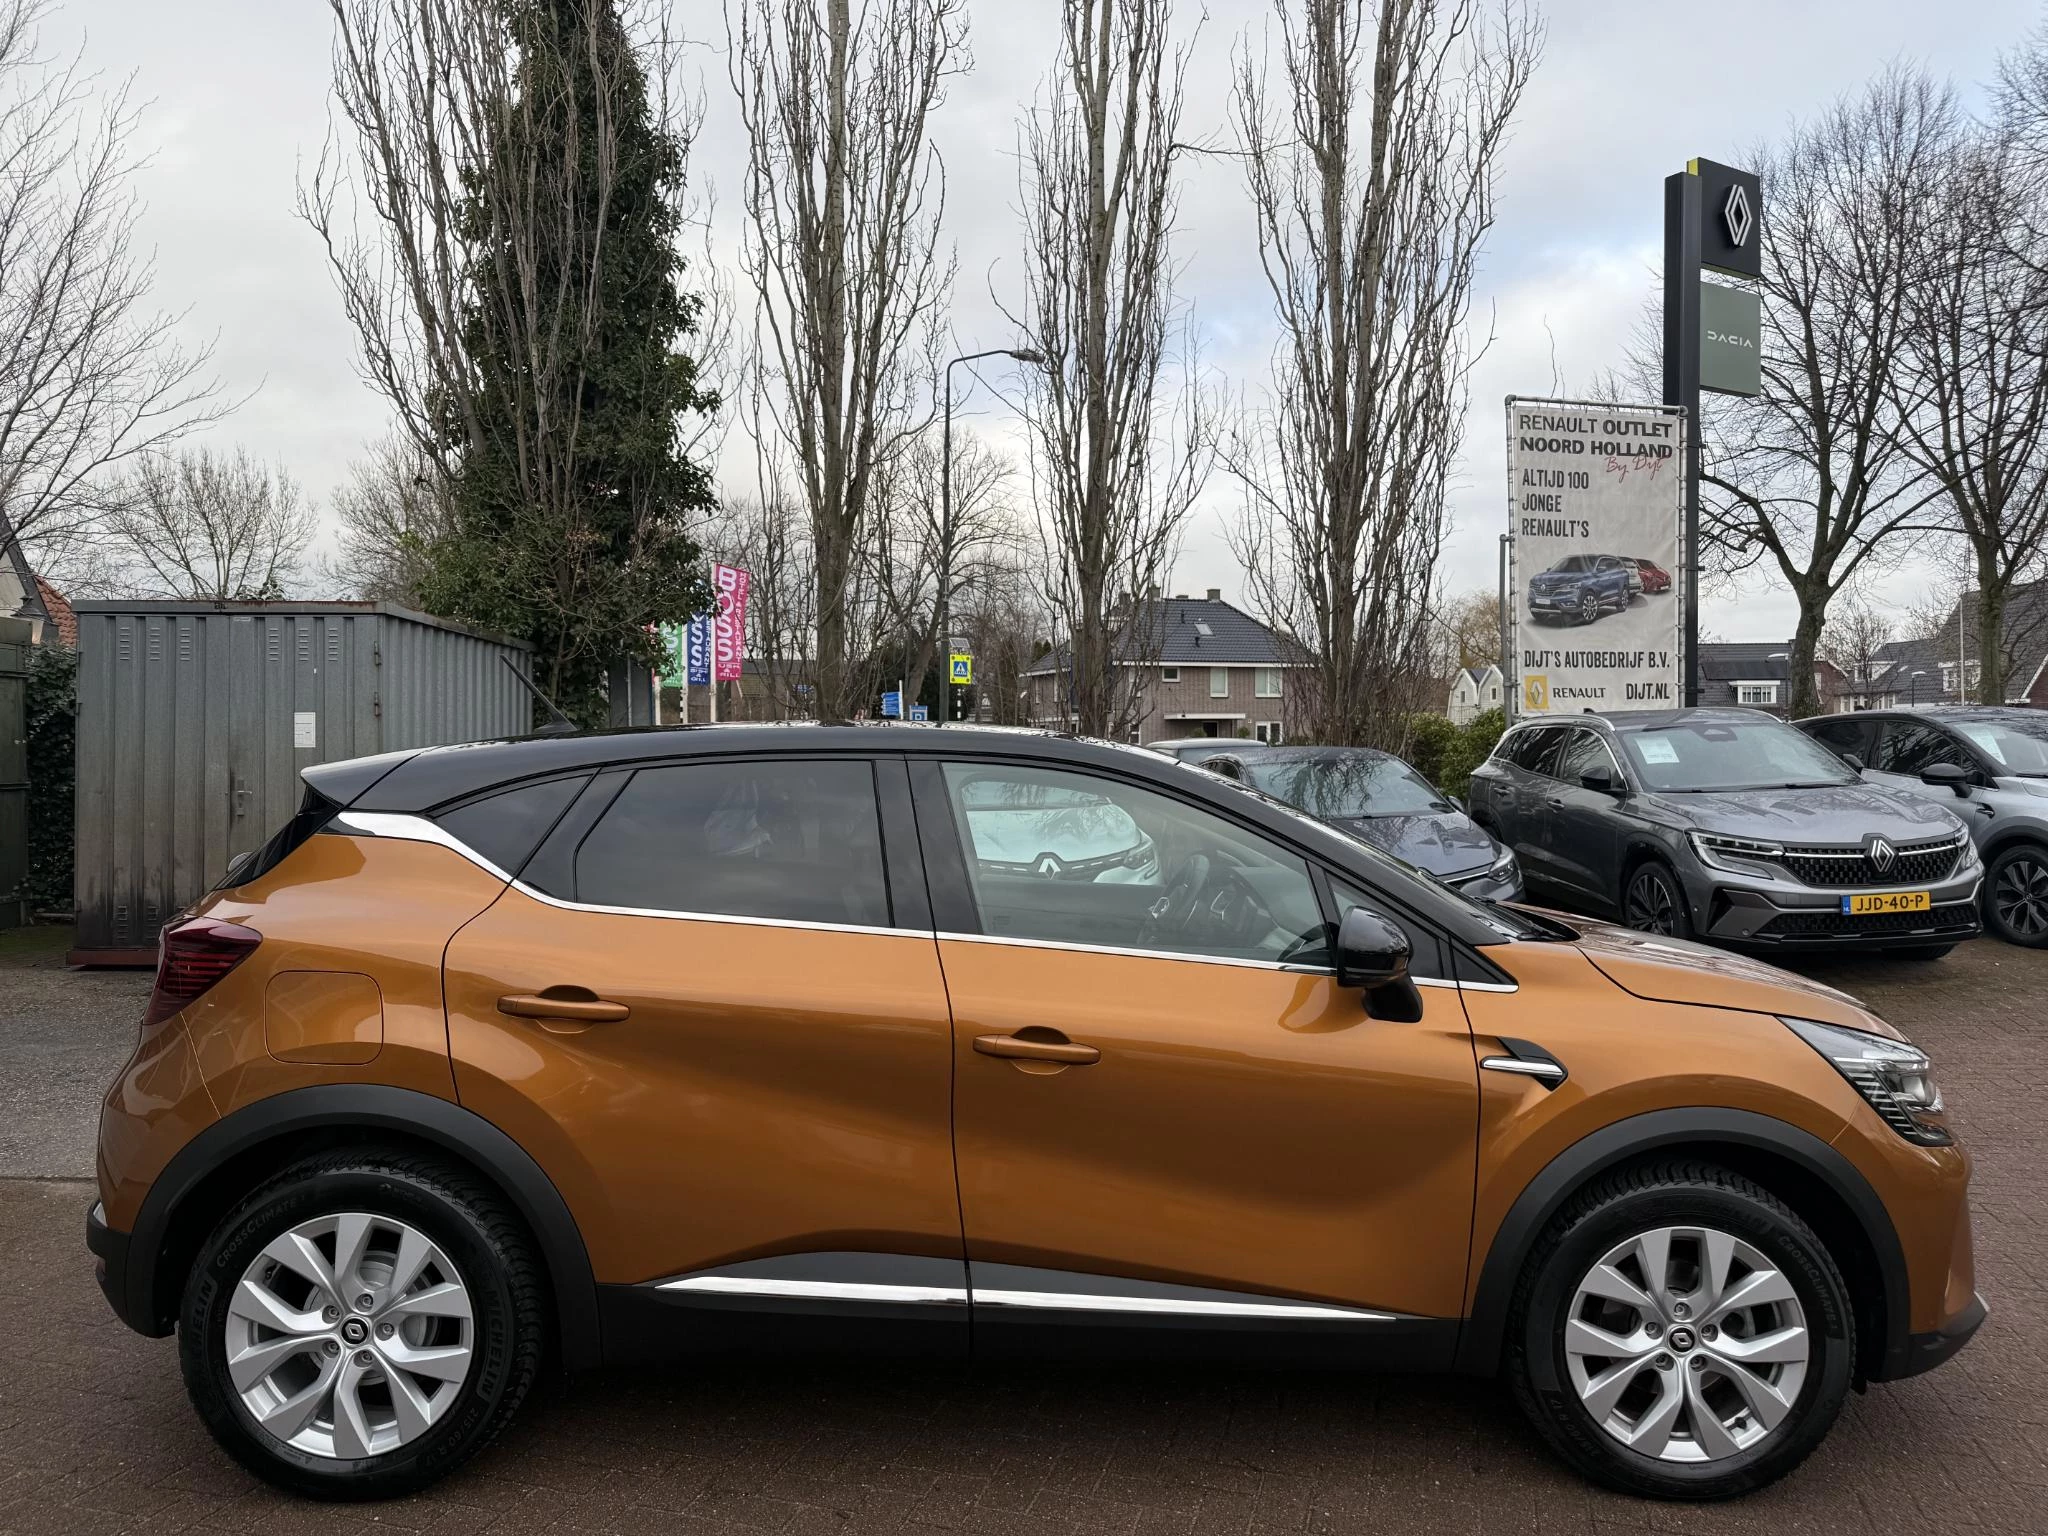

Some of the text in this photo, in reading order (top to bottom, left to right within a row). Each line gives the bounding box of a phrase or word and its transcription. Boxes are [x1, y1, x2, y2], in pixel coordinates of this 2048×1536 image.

[1707, 330, 1753, 348] DACIA
[1519, 414, 1673, 438] RENAULT OUTLET
[1520, 436, 1673, 458] NOORD HOLLAND
[1522, 468, 1589, 489] ALTIJD 100
[1604, 456, 1629, 483] By
[1521, 493, 1562, 512] JONGE
[1521, 517, 1589, 538] RENAULT'S
[1524, 650, 1670, 669] DIJT'S AUTOBEDRIJF B.V.
[1552, 682, 1670, 700] RENAULT DIJT.NL
[1856, 894, 1924, 912] JJD-40-P
